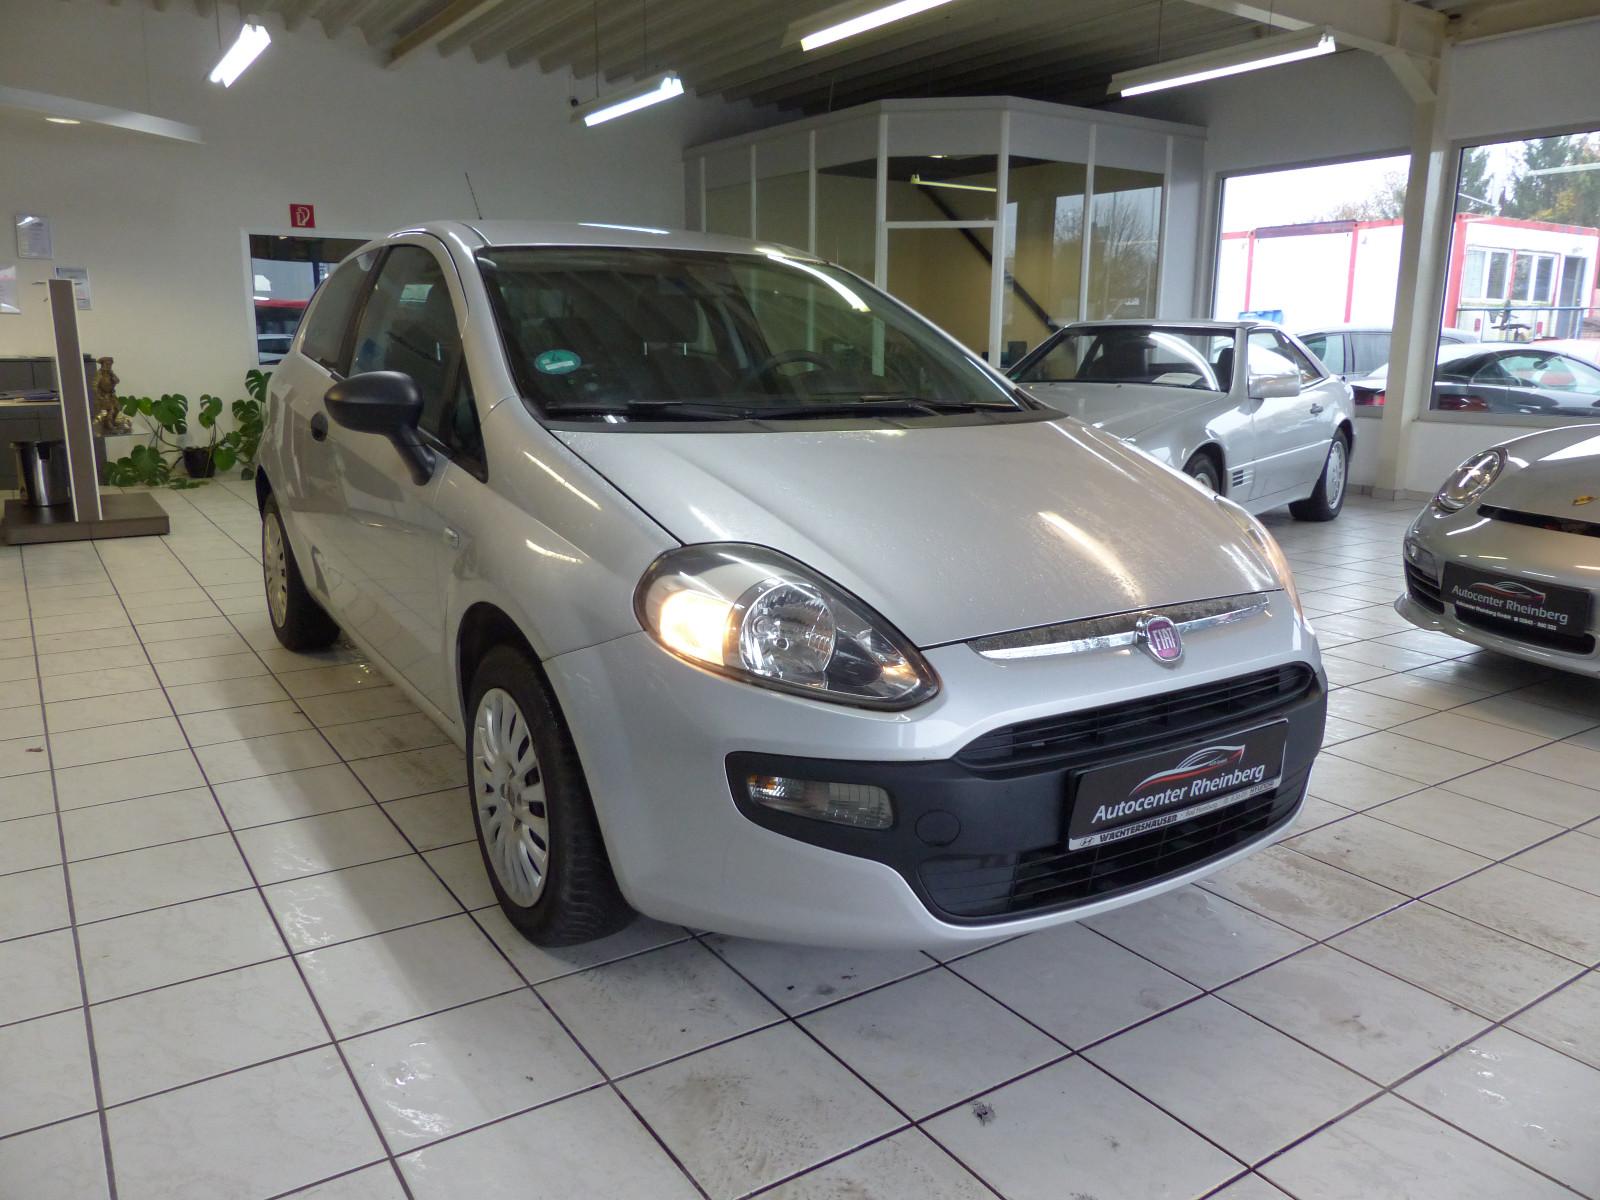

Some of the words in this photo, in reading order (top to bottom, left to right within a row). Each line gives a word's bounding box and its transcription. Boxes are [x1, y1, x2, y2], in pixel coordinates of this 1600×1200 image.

[1451, 584, 1505, 607] Autocenter
[1505, 600, 1569, 625] Rheinberg
[1152, 626, 1177, 651] FIAT
[1091, 786, 1188, 824] Autocenter
[1189, 764, 1266, 797] Rheinberg
